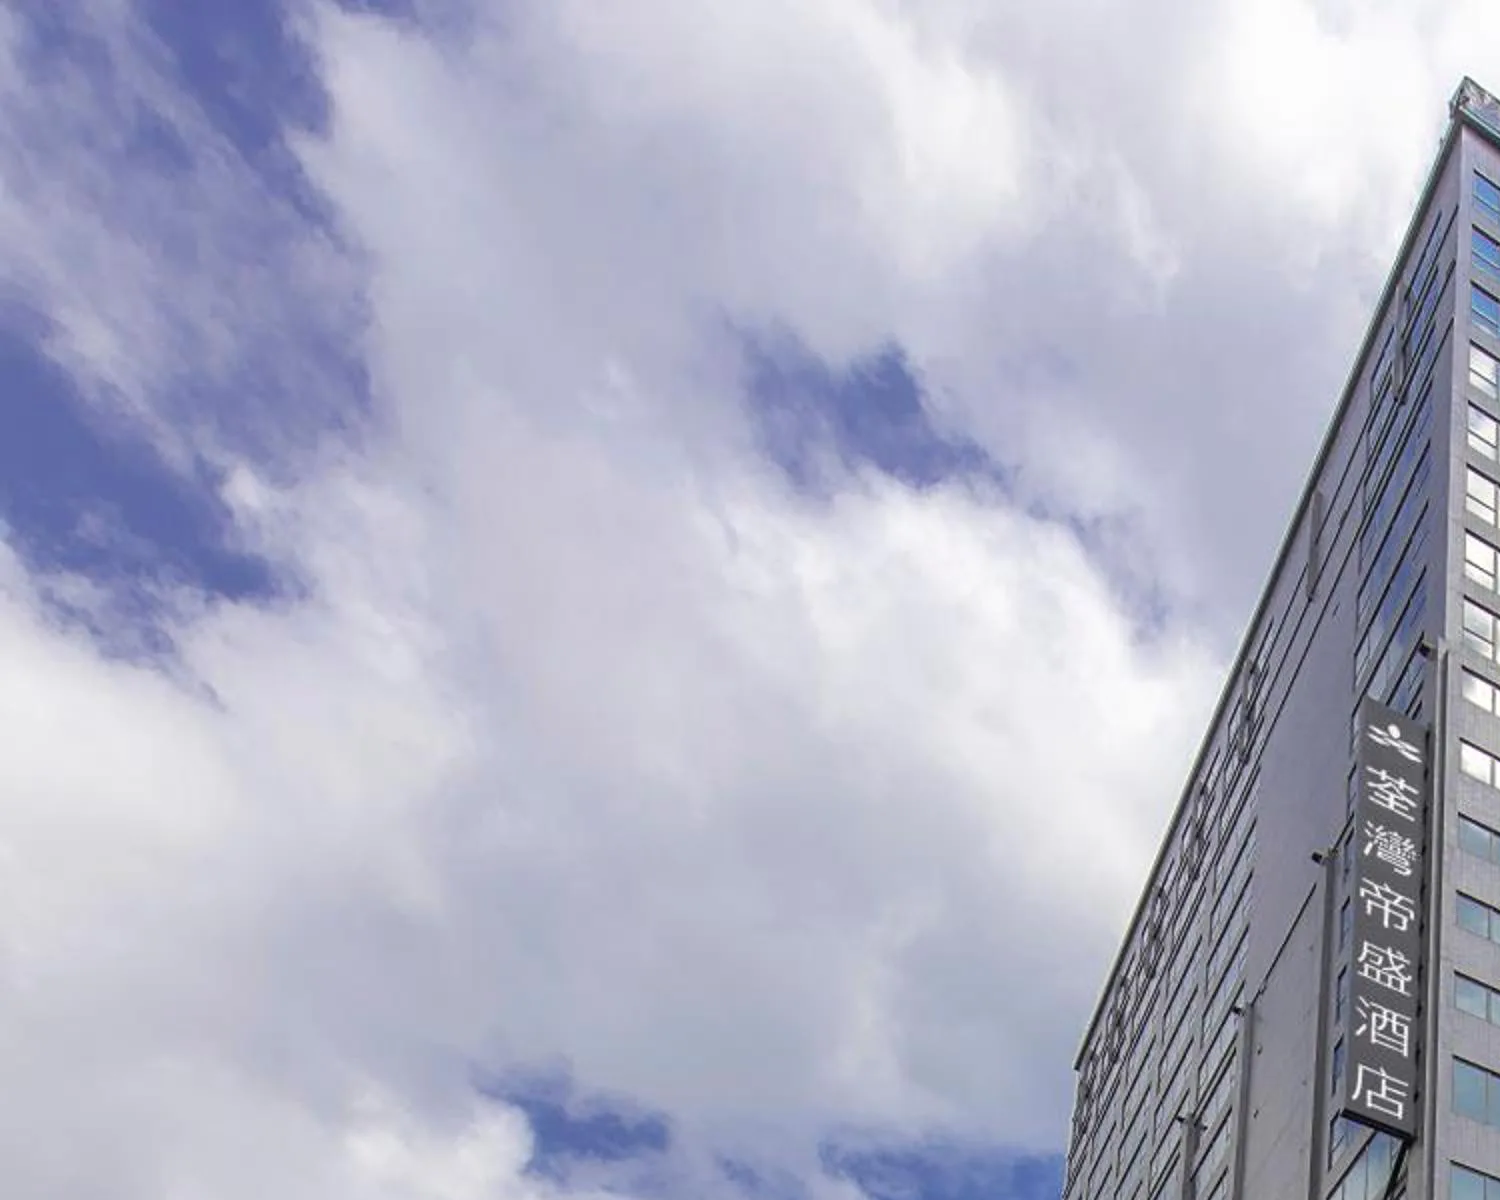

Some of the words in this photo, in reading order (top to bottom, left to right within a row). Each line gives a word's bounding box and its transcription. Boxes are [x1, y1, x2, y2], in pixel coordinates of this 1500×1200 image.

[1352, 764, 1421, 1120] 荃灣帝盛酒店
